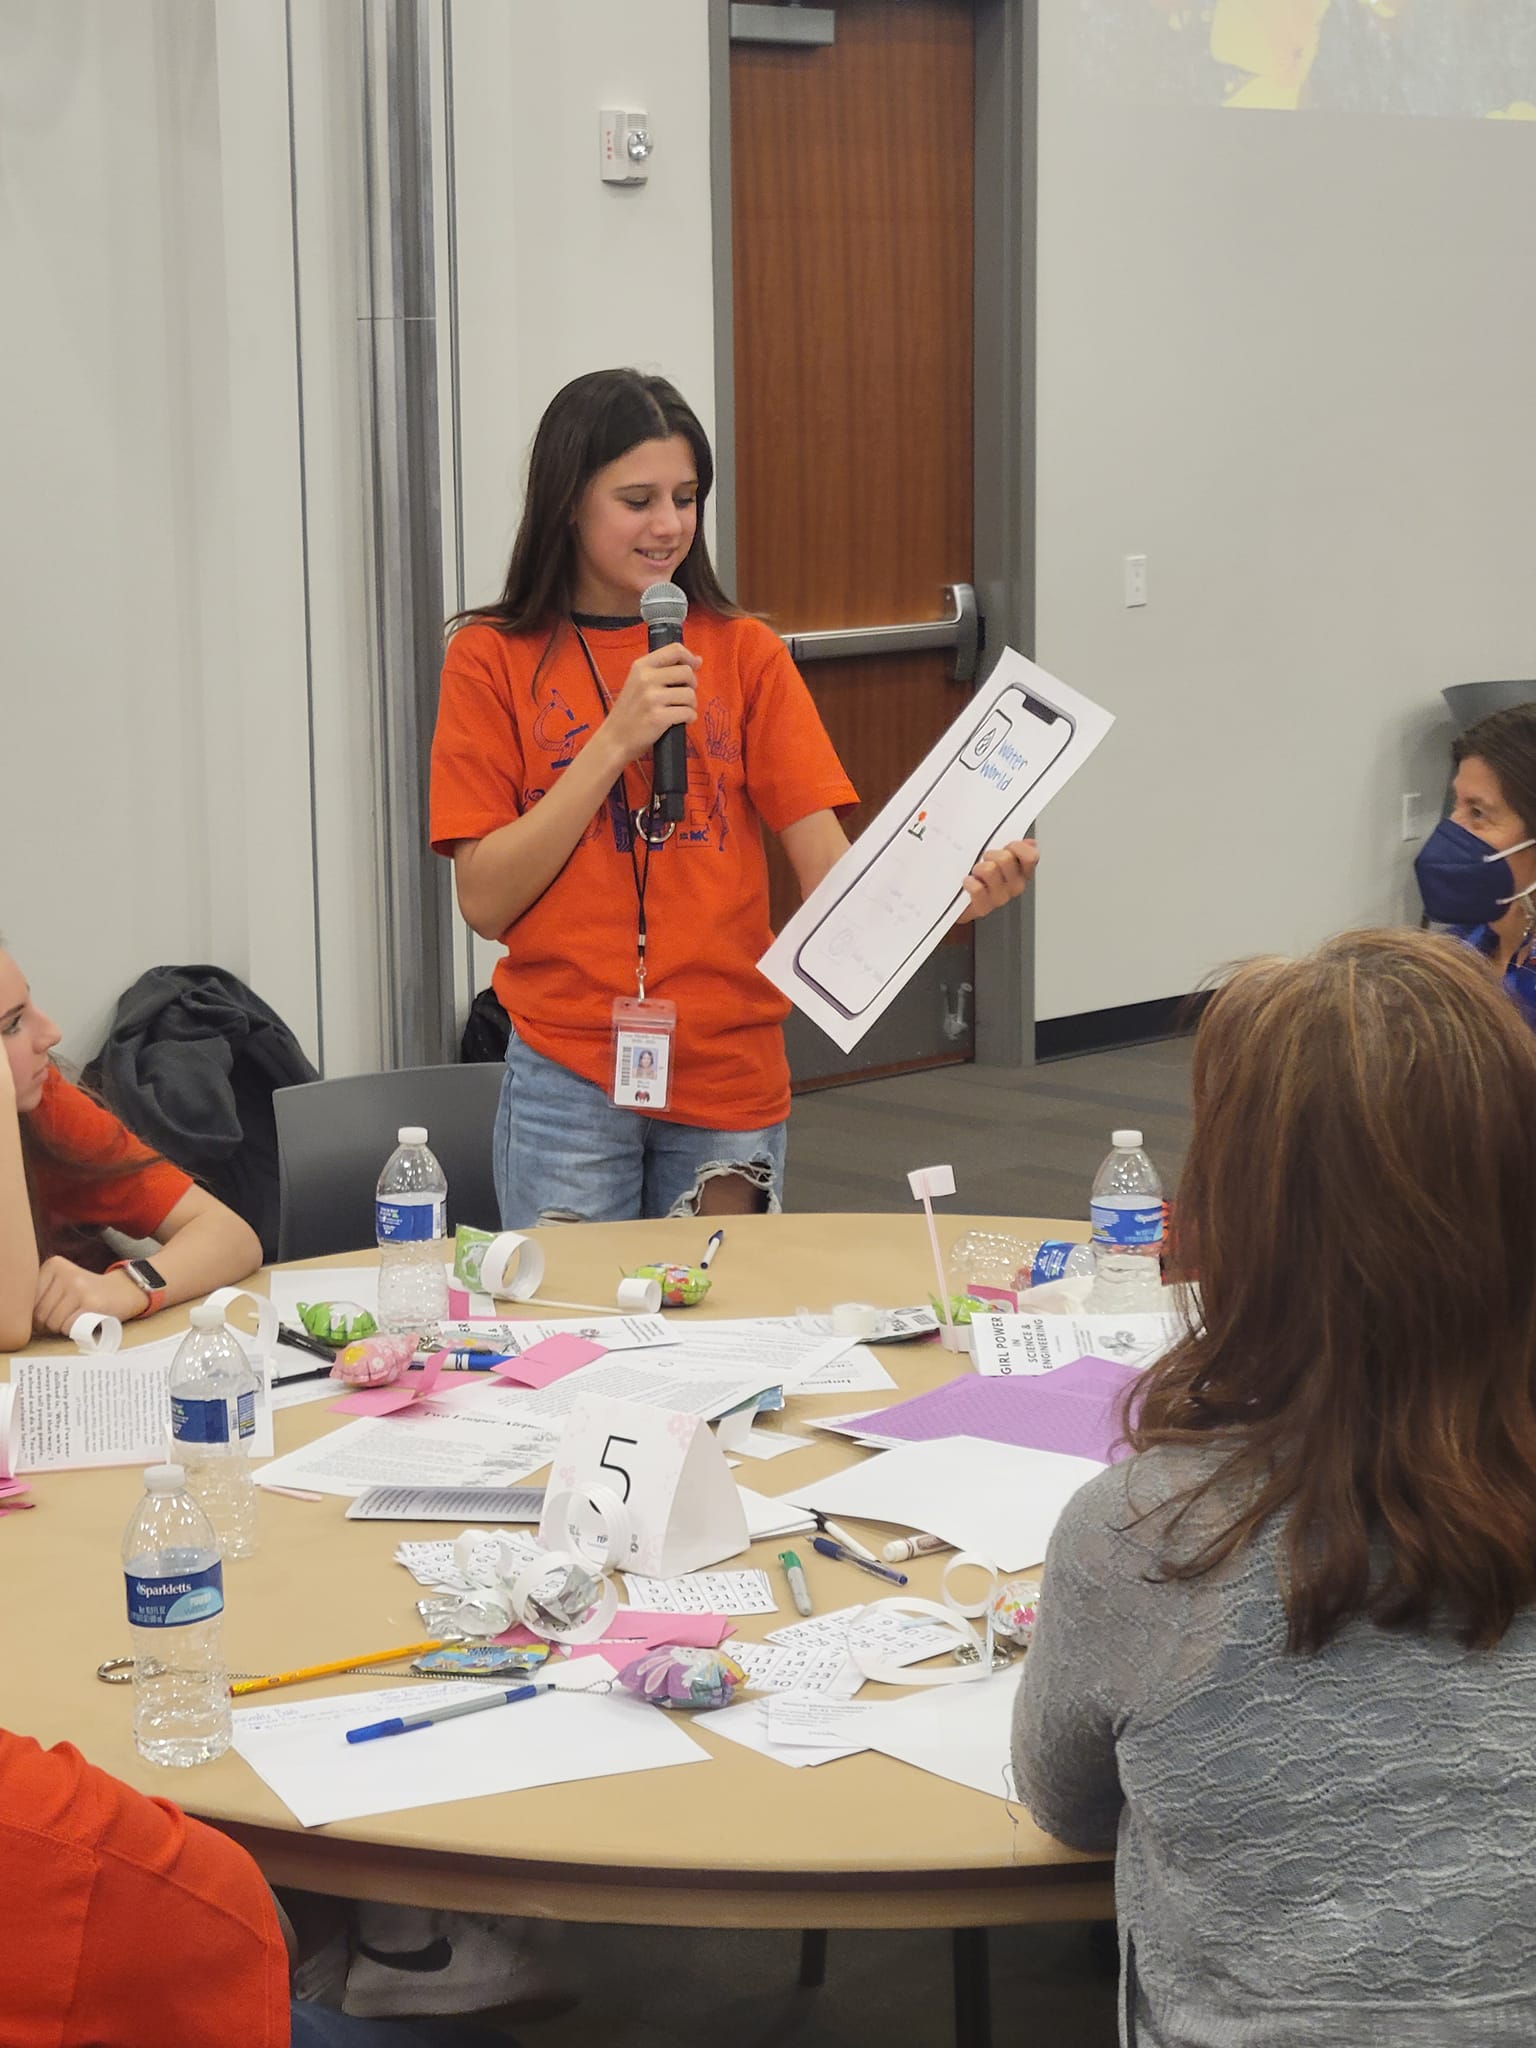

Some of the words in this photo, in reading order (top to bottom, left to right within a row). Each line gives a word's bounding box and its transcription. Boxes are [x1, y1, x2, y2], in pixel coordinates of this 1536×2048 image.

[998, 739, 1028, 770] Water
[980, 760, 1014, 791] World
[991, 1316, 1008, 1349] POWER
[1010, 1338, 1021, 1347] IN
[1022, 1331, 1038, 1363] SCIENCE
[1034, 1319, 1053, 1369] ENGINEERING
[998, 1352, 1012, 1375] GIRL
[589, 1435, 637, 1514] 5
[140, 1583, 192, 1599] Sparkletts
